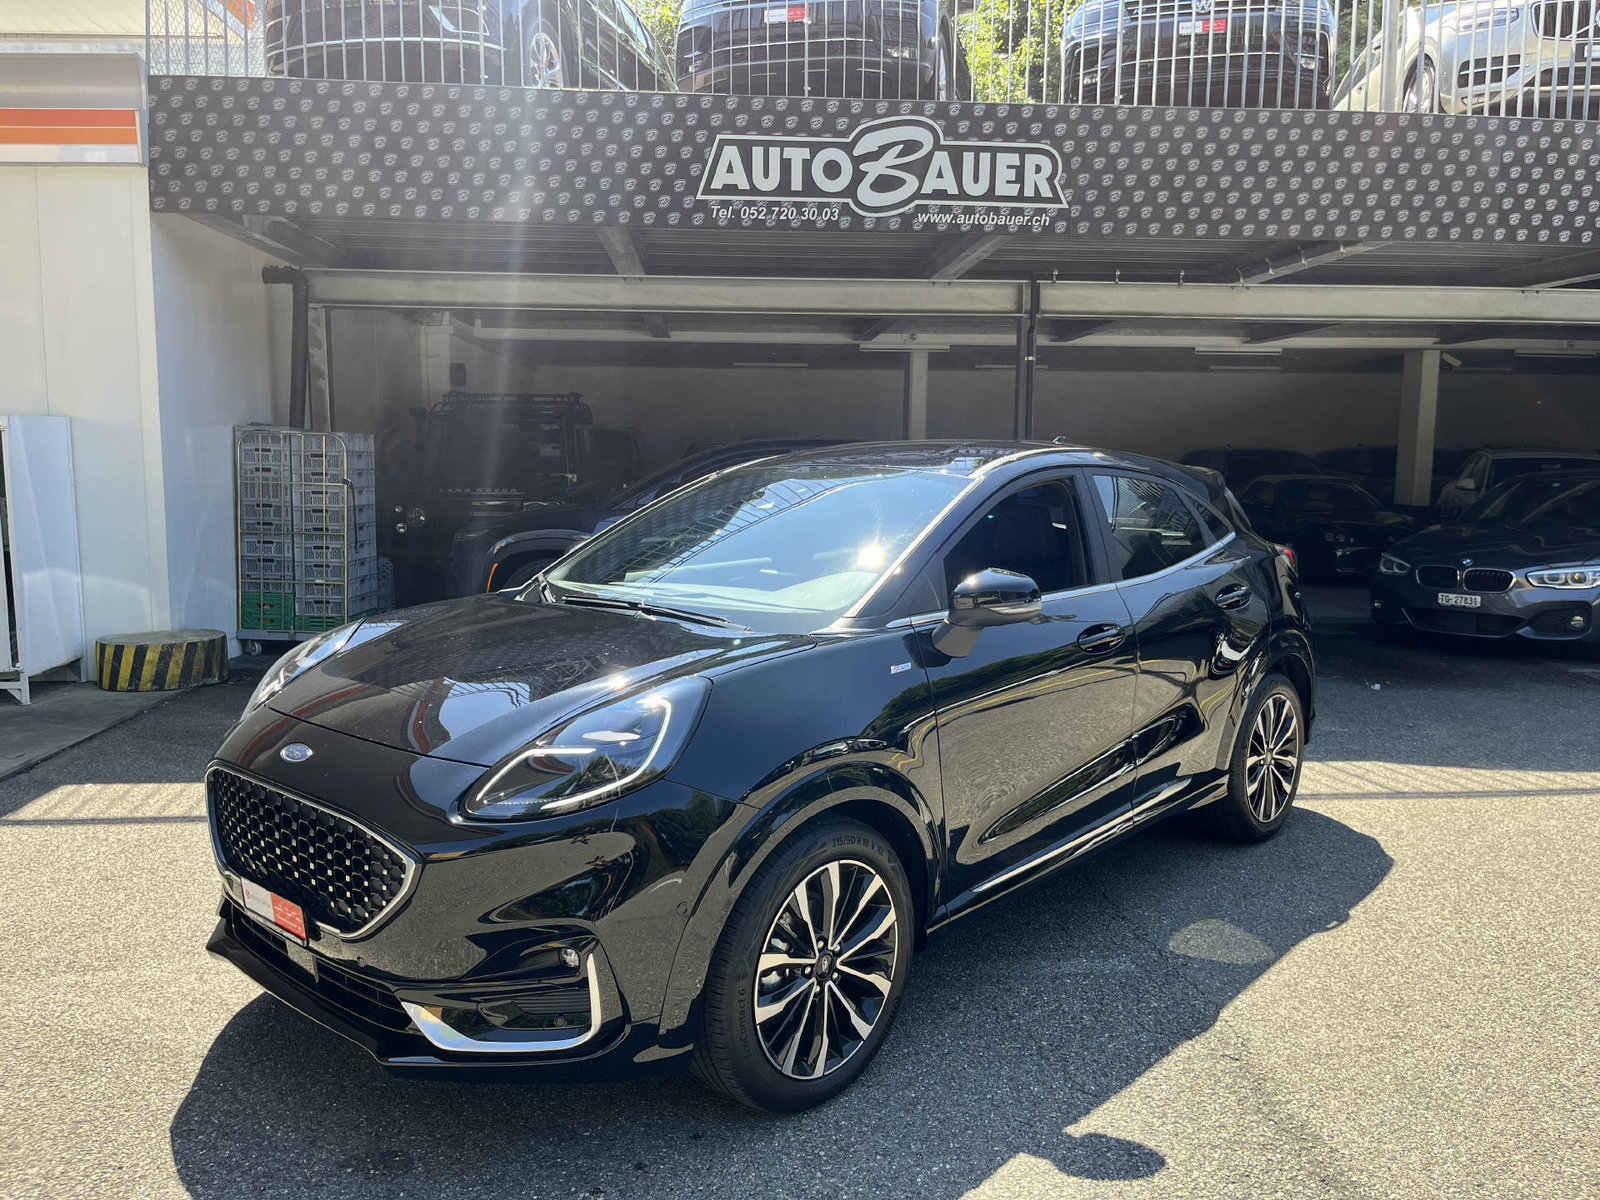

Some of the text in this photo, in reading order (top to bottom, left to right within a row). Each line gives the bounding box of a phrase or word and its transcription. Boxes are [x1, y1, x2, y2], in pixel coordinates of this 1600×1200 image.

[710, 125, 1054, 207] AUTO BAUER
[710, 205, 840, 221] Tel. 052 720 30 03
[917, 212, 1050, 226] www.autobauer.ch
